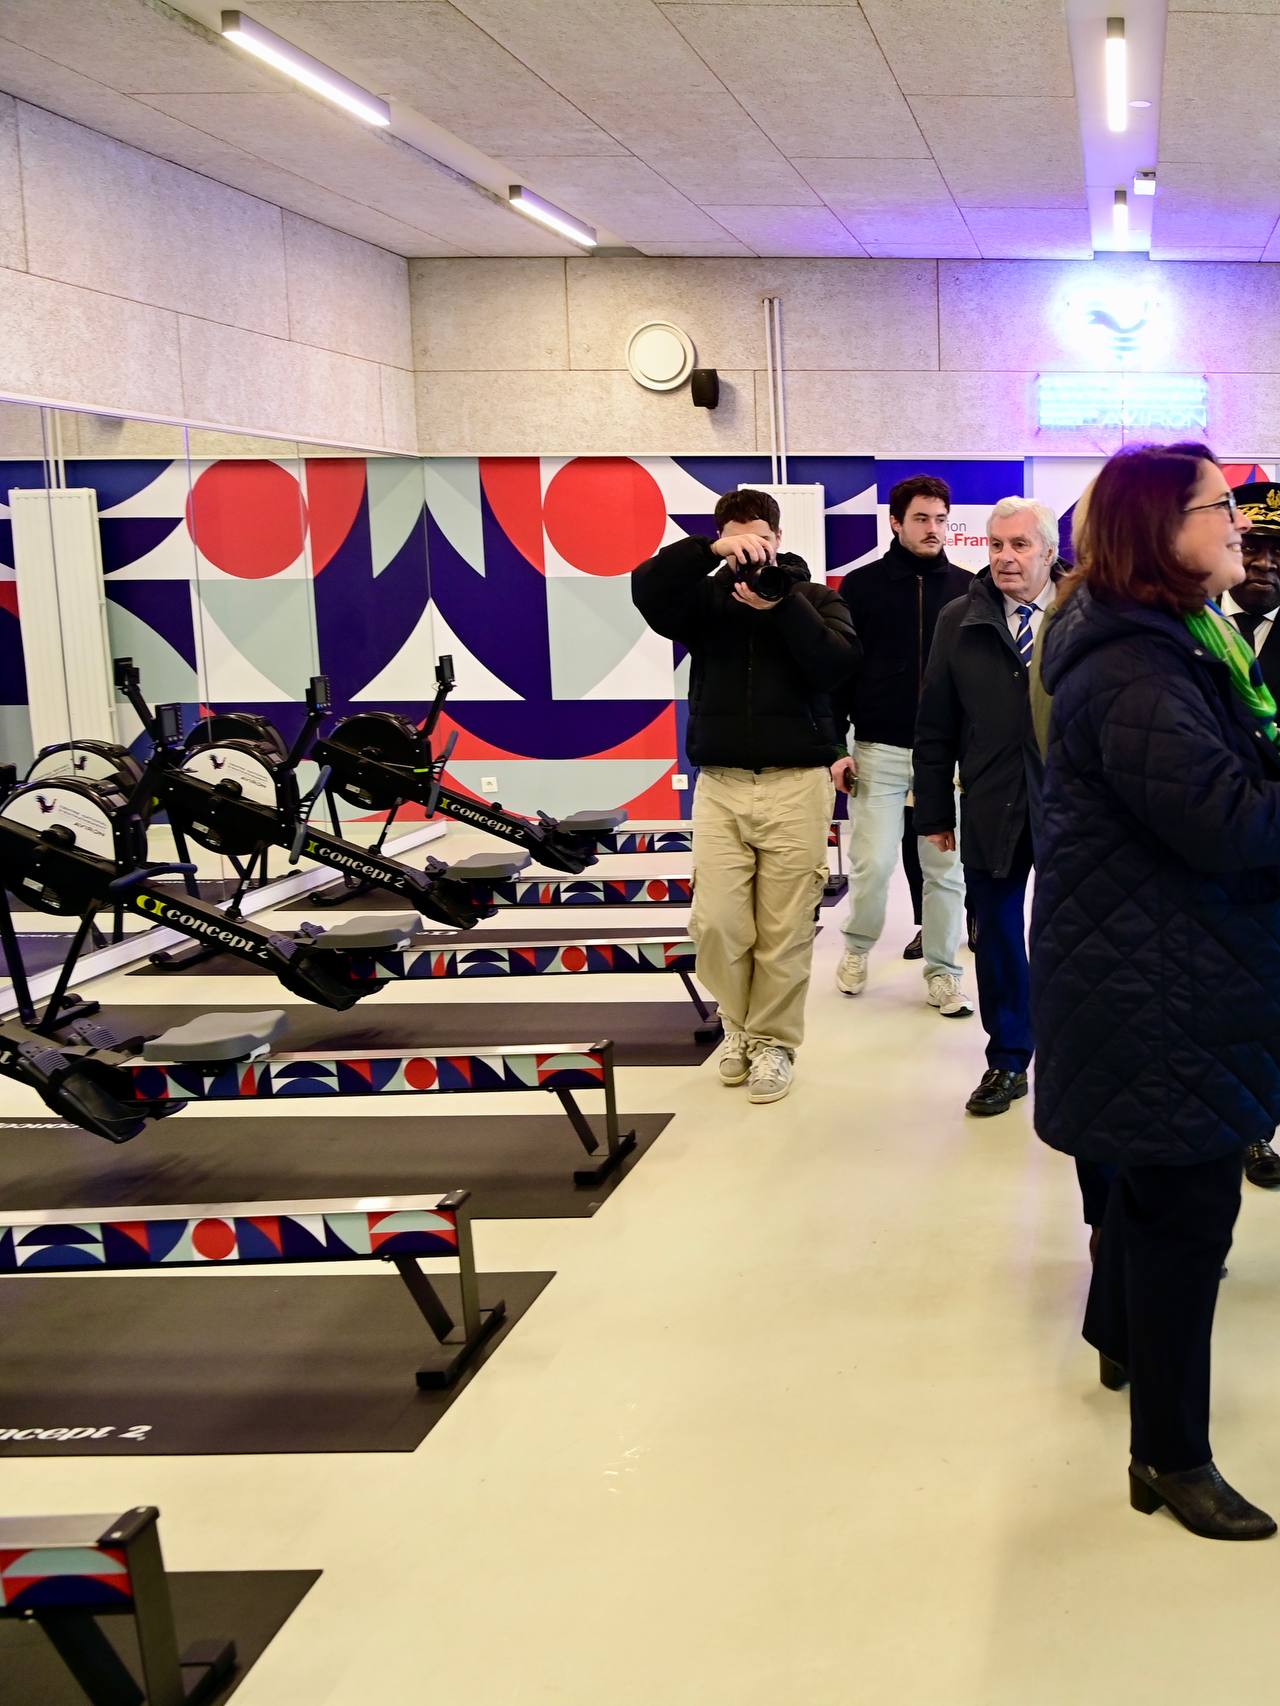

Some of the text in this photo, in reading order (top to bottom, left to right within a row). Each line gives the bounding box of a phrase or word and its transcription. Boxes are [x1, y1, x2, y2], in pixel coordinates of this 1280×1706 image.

[450, 803, 525, 839] concept 2
[318, 847, 406, 888] concept 2
[166, 909, 256, 953] concept
